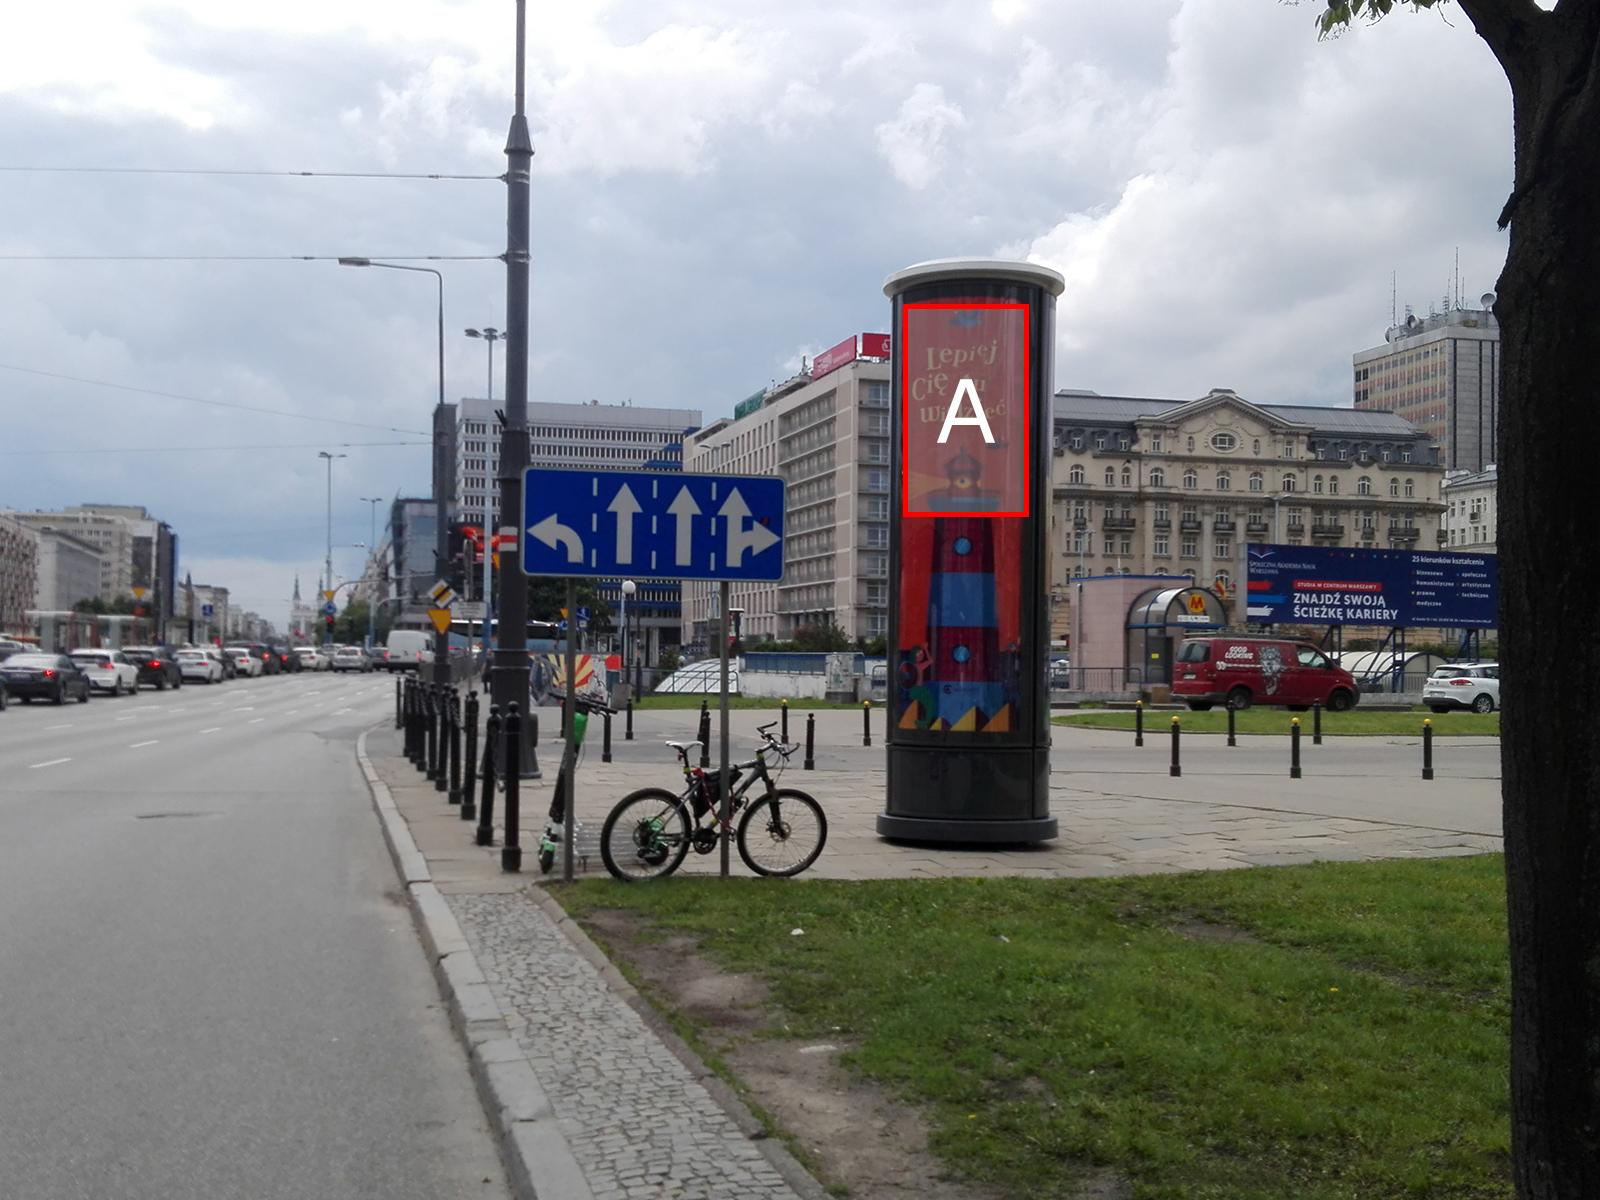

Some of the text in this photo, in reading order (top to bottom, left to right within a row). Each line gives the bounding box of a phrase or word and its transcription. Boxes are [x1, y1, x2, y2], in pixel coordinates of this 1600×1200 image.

[926, 339, 999, 370] Lepiej
[911, 372, 949, 401] Cię
[1412, 555, 1485, 566] 25 kierunków kształcenia
[1293, 592, 1386, 608] ZNAJDŹ SWOJĄ
[1293, 605, 1344, 620] ŚCIEŻKĘ
[1346, 608, 1398, 620] KARIERY
